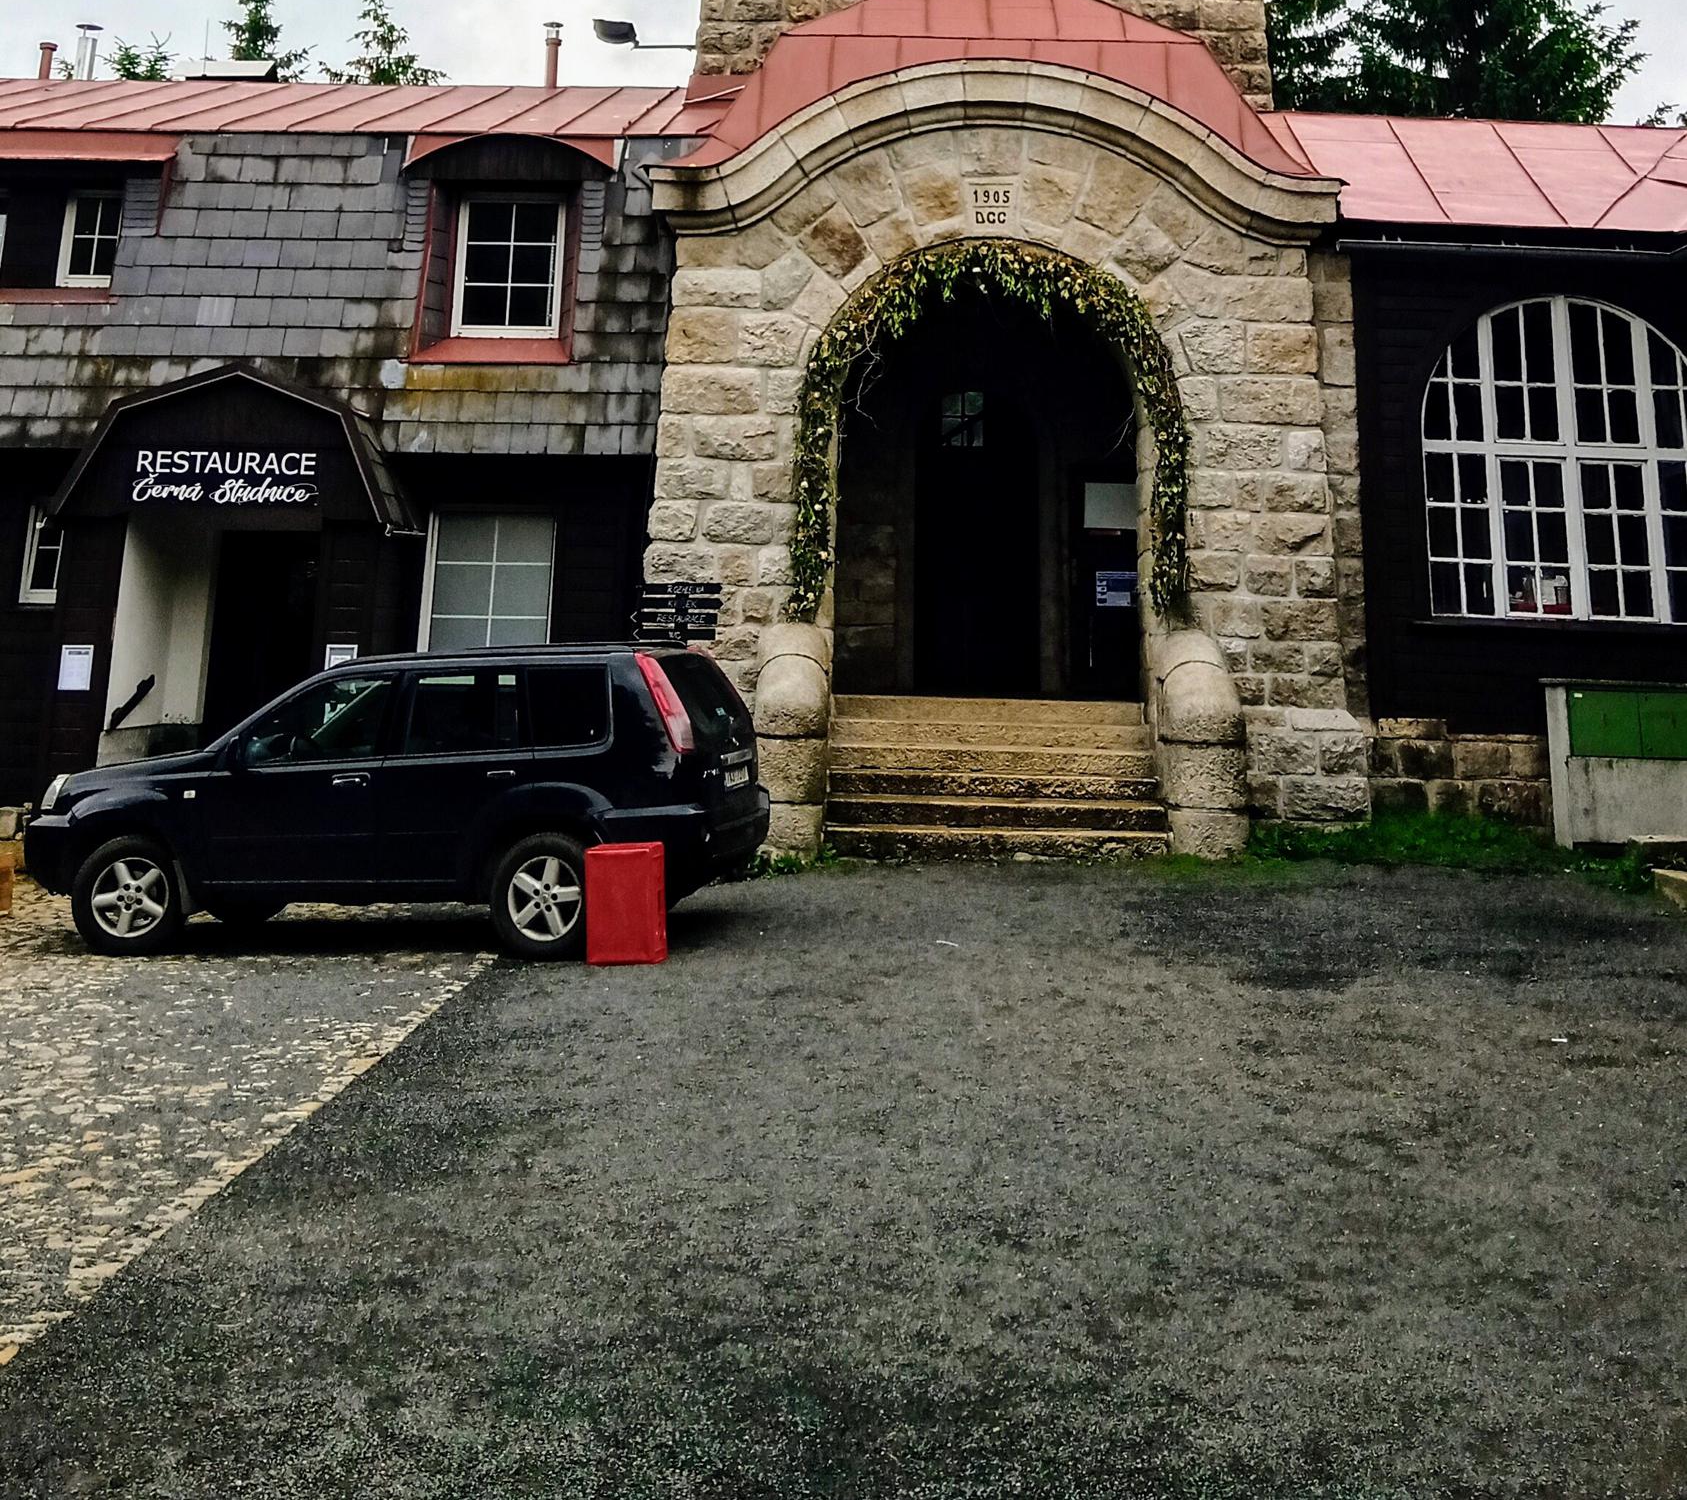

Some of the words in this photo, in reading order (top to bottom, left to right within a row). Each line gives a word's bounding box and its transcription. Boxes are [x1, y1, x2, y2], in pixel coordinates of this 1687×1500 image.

[973, 189, 1010, 204] 1905
[136, 450, 317, 476] RESTAURACE
[132, 473, 204, 502] Černá
[209, 477, 319, 505] Studnice
